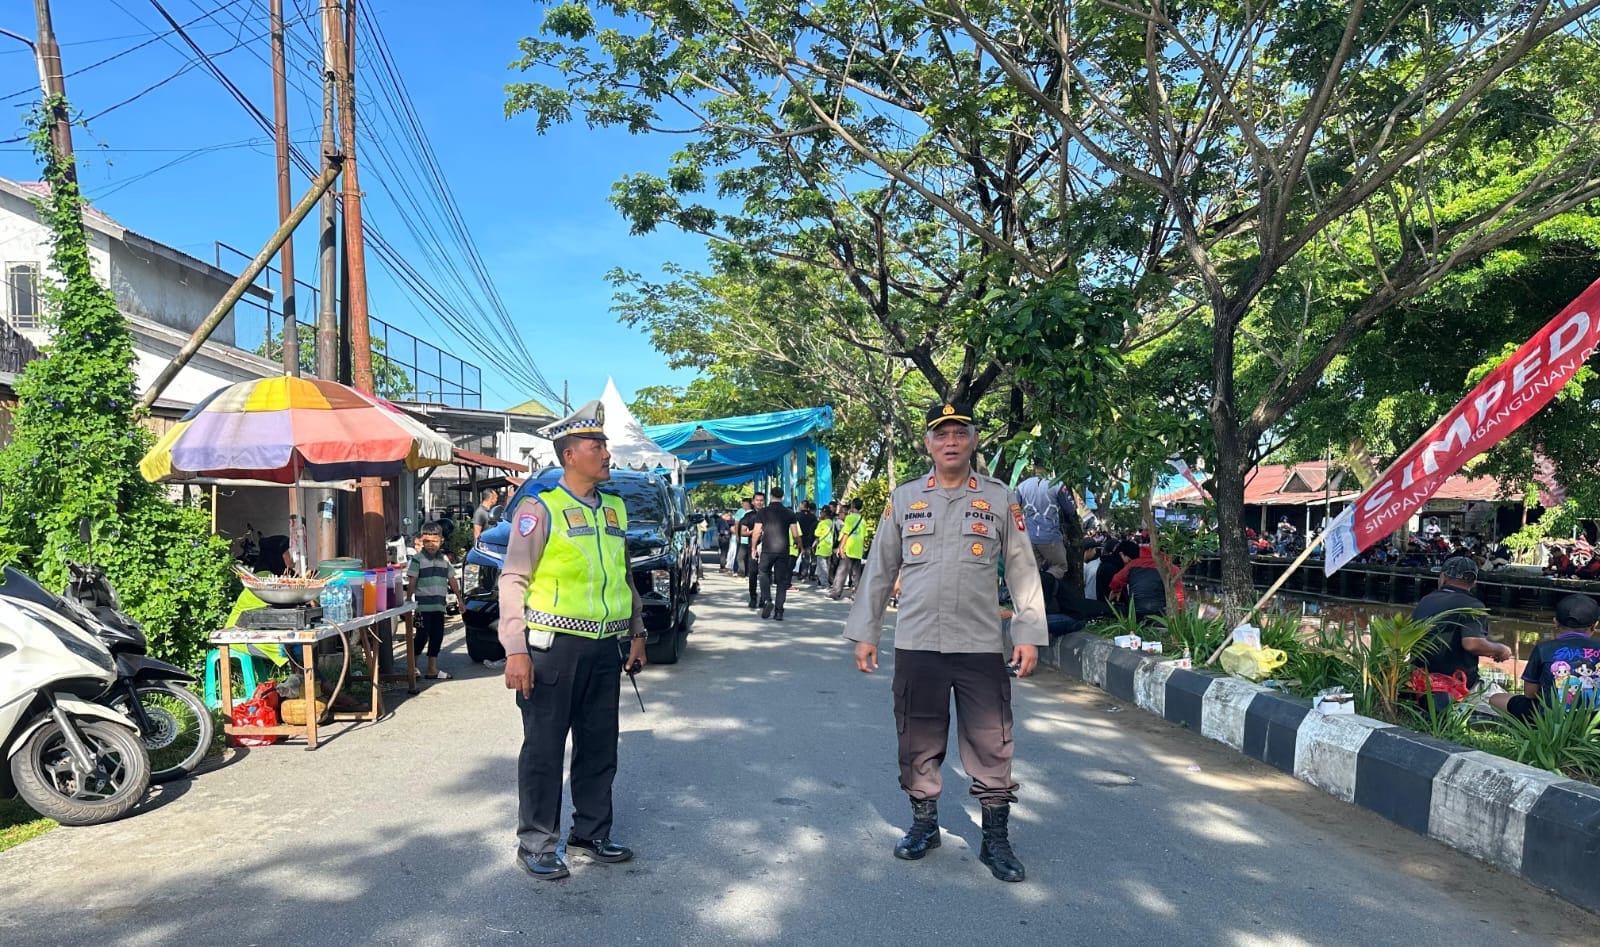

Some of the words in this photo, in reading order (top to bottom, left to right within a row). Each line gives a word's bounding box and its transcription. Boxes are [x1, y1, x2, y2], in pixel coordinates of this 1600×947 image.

[1364, 311, 1600, 519] SIMPED
[965, 511, 994, 522] POLRI
[1365, 479, 1438, 534] SIMPAN
